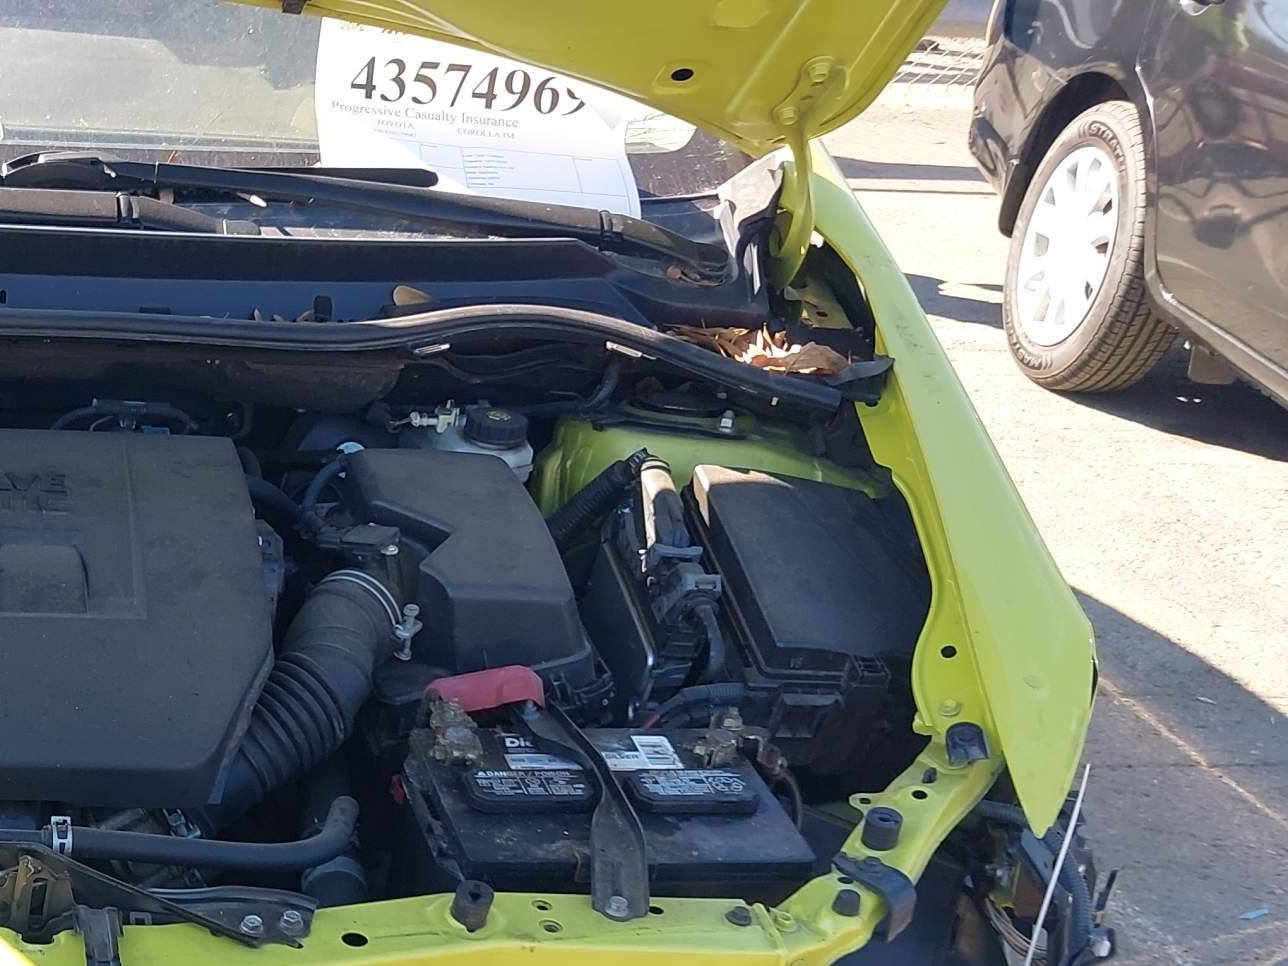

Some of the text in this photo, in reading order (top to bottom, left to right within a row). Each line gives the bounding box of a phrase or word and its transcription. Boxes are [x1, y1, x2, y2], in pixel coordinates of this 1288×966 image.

[330, 100, 520, 128] Progressive Casualty Insurance
